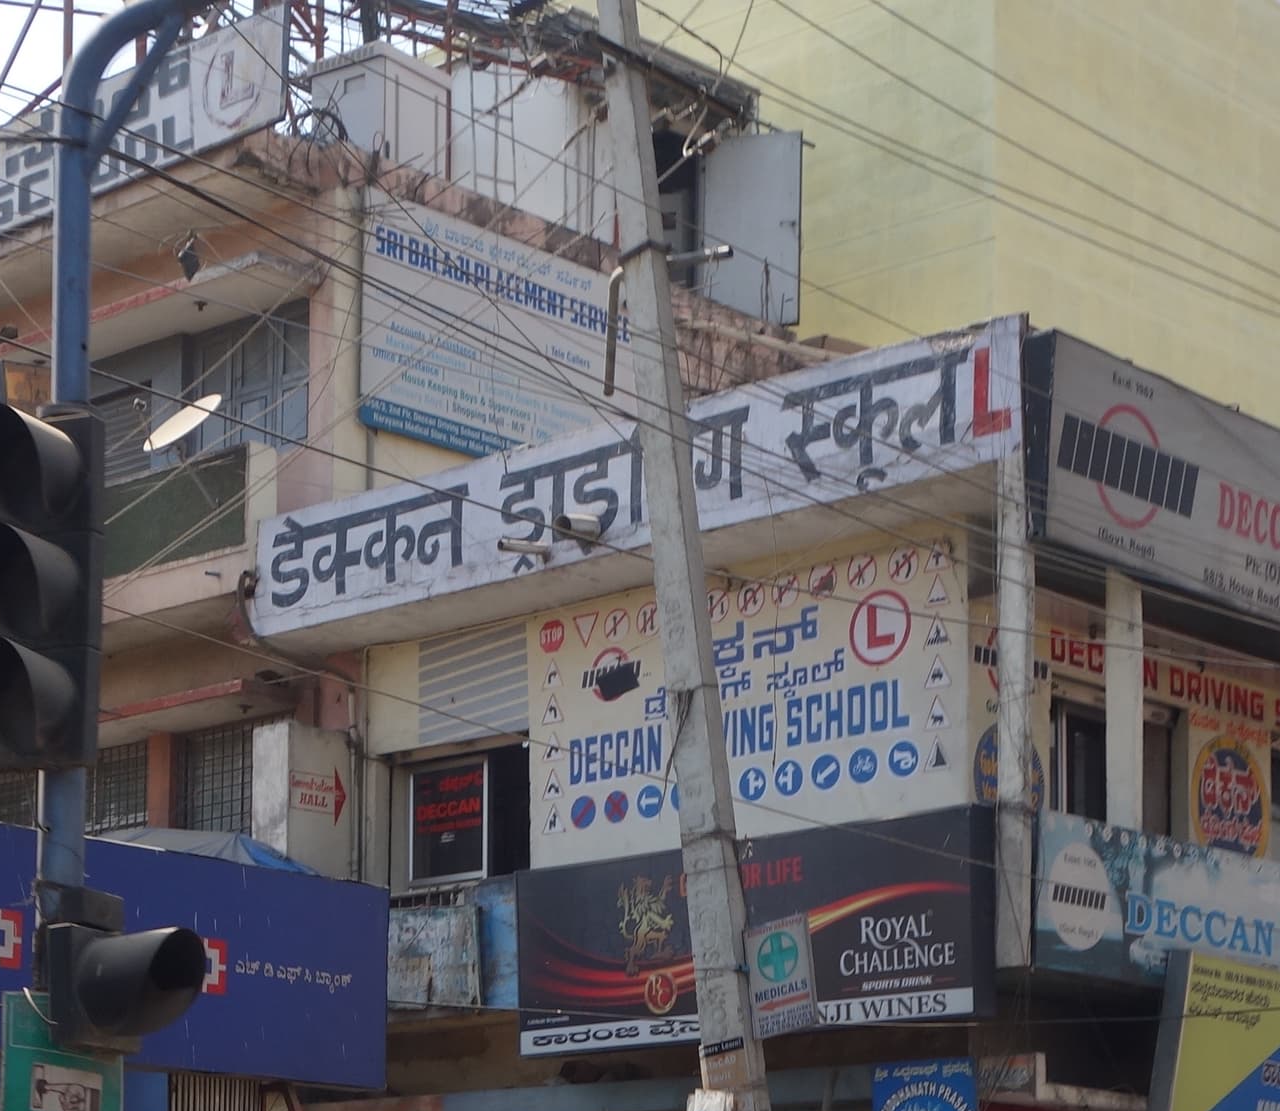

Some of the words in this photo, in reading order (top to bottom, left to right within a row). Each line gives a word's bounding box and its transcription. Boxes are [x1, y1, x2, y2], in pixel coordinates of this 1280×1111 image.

[971, 347, 1012, 438] L
[271, 483, 469, 609] डेक्कन
[782, 348, 970, 495] स्कूल
[540, 625, 565, 645] STOP
[1169, 666, 1265, 722] DRIVING
[569, 723, 663, 786] DECCAN
[785, 678, 910, 748] SCHOOL
[299, 792, 329, 809] HALL
[767, 856, 804, 884] LIFE
[860, 913, 933, 949] ROYAL
[1124, 889, 1276, 958] DECCAN
[840, 941, 956, 977] CHALLENGE
[754, 978, 808, 1002] MEDICALS
[861, 978, 900, 992] SPORTS
[901, 975, 933, 988] DRINK
[859, 992, 948, 1020] WINES
